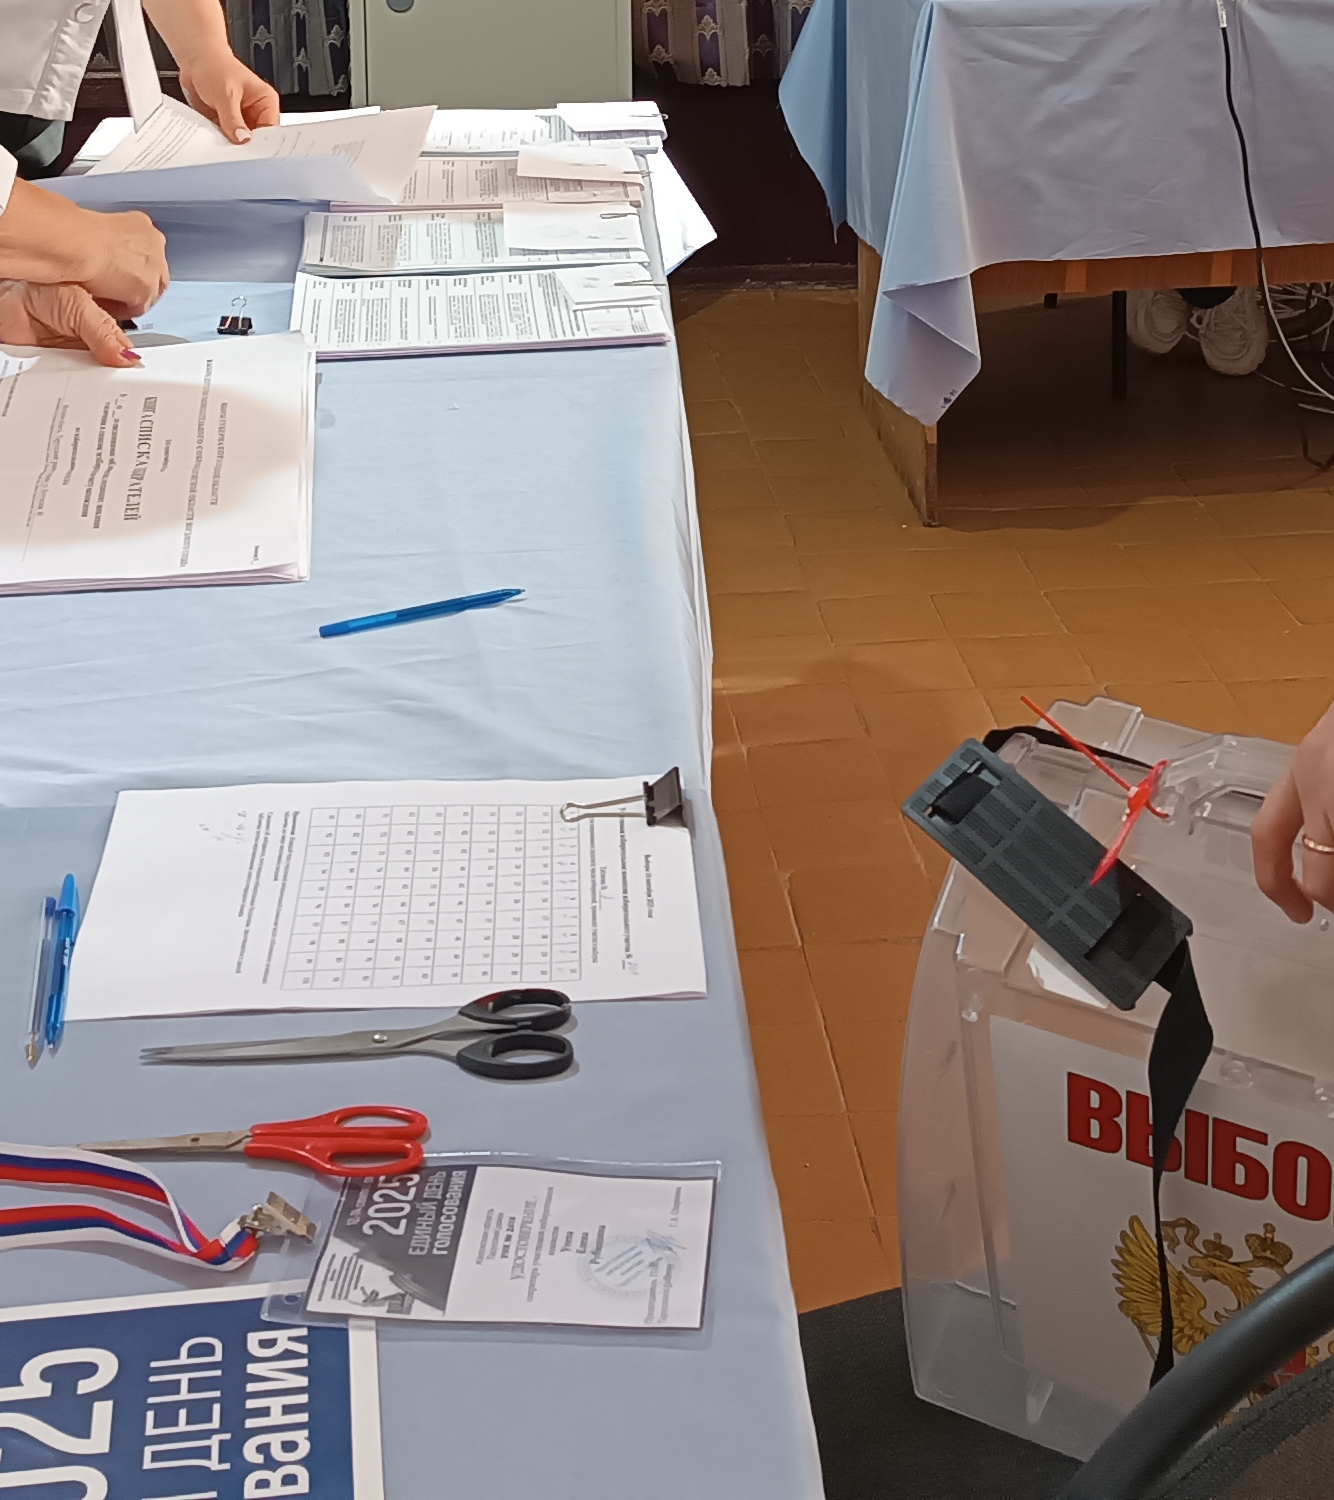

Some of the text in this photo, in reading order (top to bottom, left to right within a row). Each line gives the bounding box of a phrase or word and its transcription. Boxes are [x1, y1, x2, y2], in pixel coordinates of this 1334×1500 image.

[362, 1174, 420, 1235] 2025
[409, 1171, 446, 1255] ЕДИНЫЙ ДЕНЬ
[143, 1335, 233, 1471] ДЕНЬ
